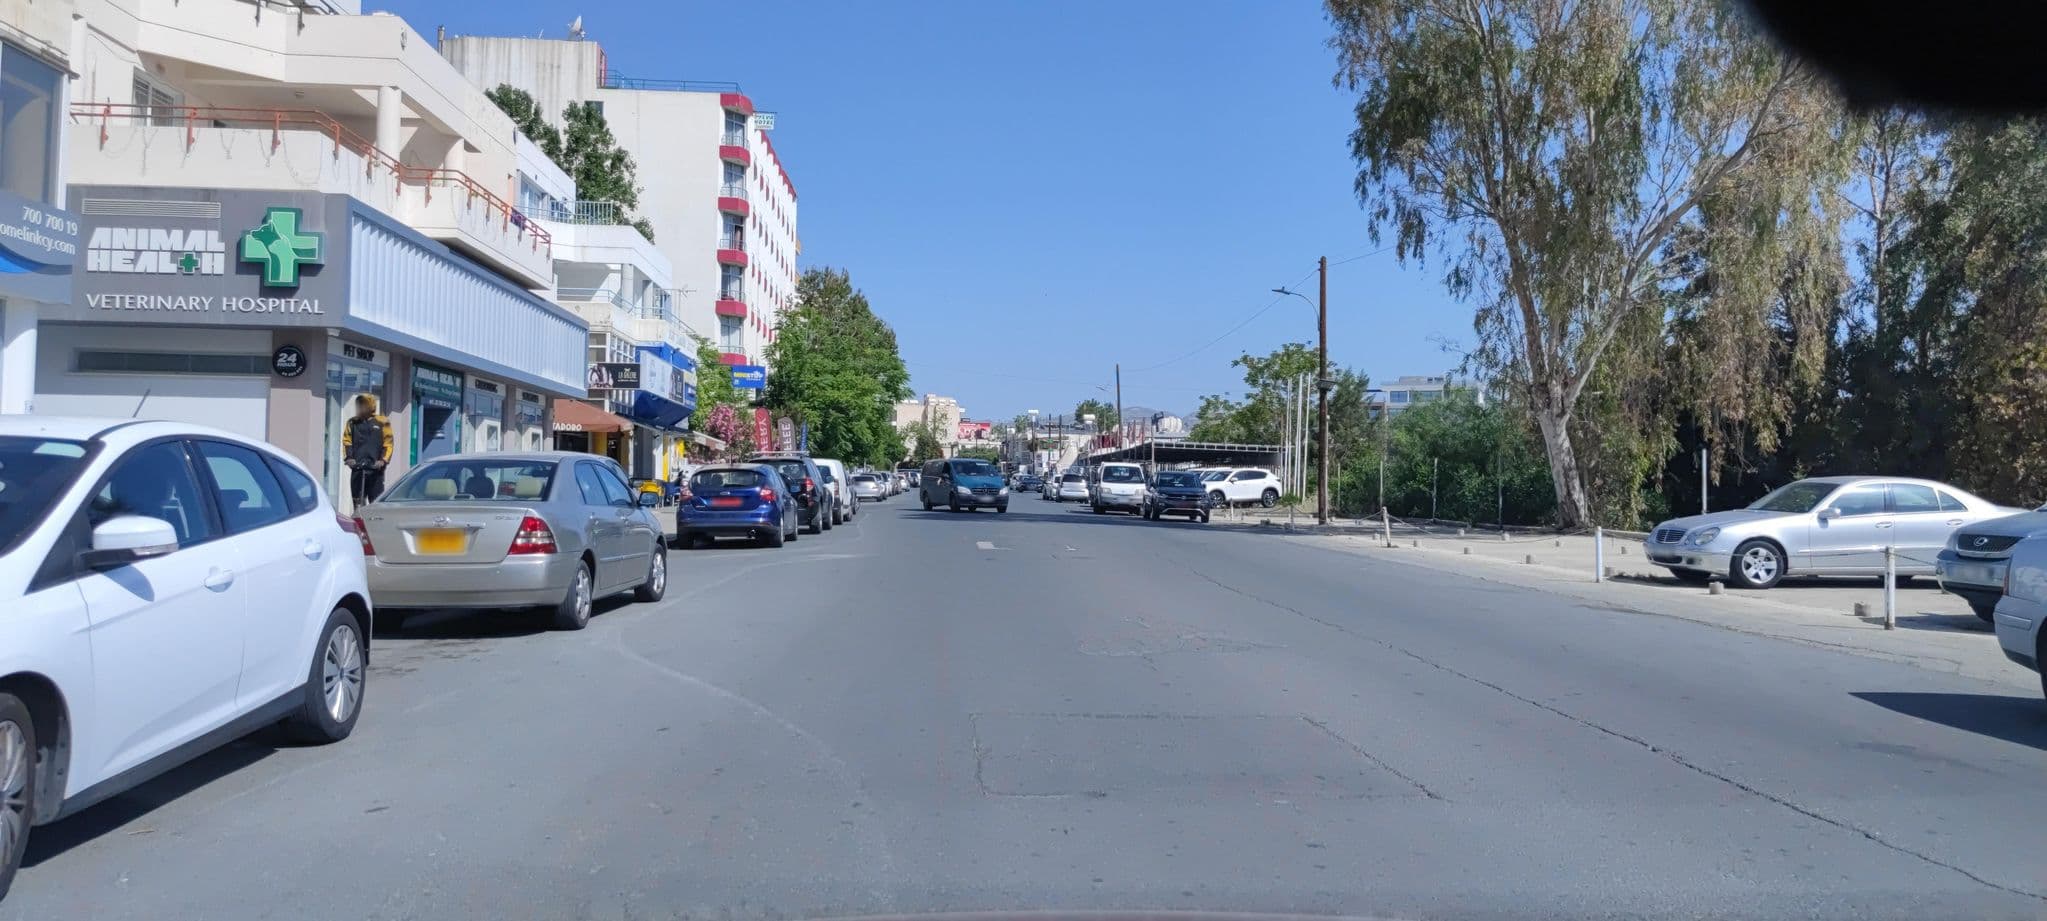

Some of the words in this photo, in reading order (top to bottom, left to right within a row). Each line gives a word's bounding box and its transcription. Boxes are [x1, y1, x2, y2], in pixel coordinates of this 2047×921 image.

[23, 206, 42, 225] 700
[45, 213, 64, 232] 700
[66, 220, 78, 236] 19
[87, 227, 226, 252] ANIMAL
[86, 294, 214, 311] VETERINARY
[222, 297, 325, 315] HOSPITAL
[277, 352, 297, 363] 24
